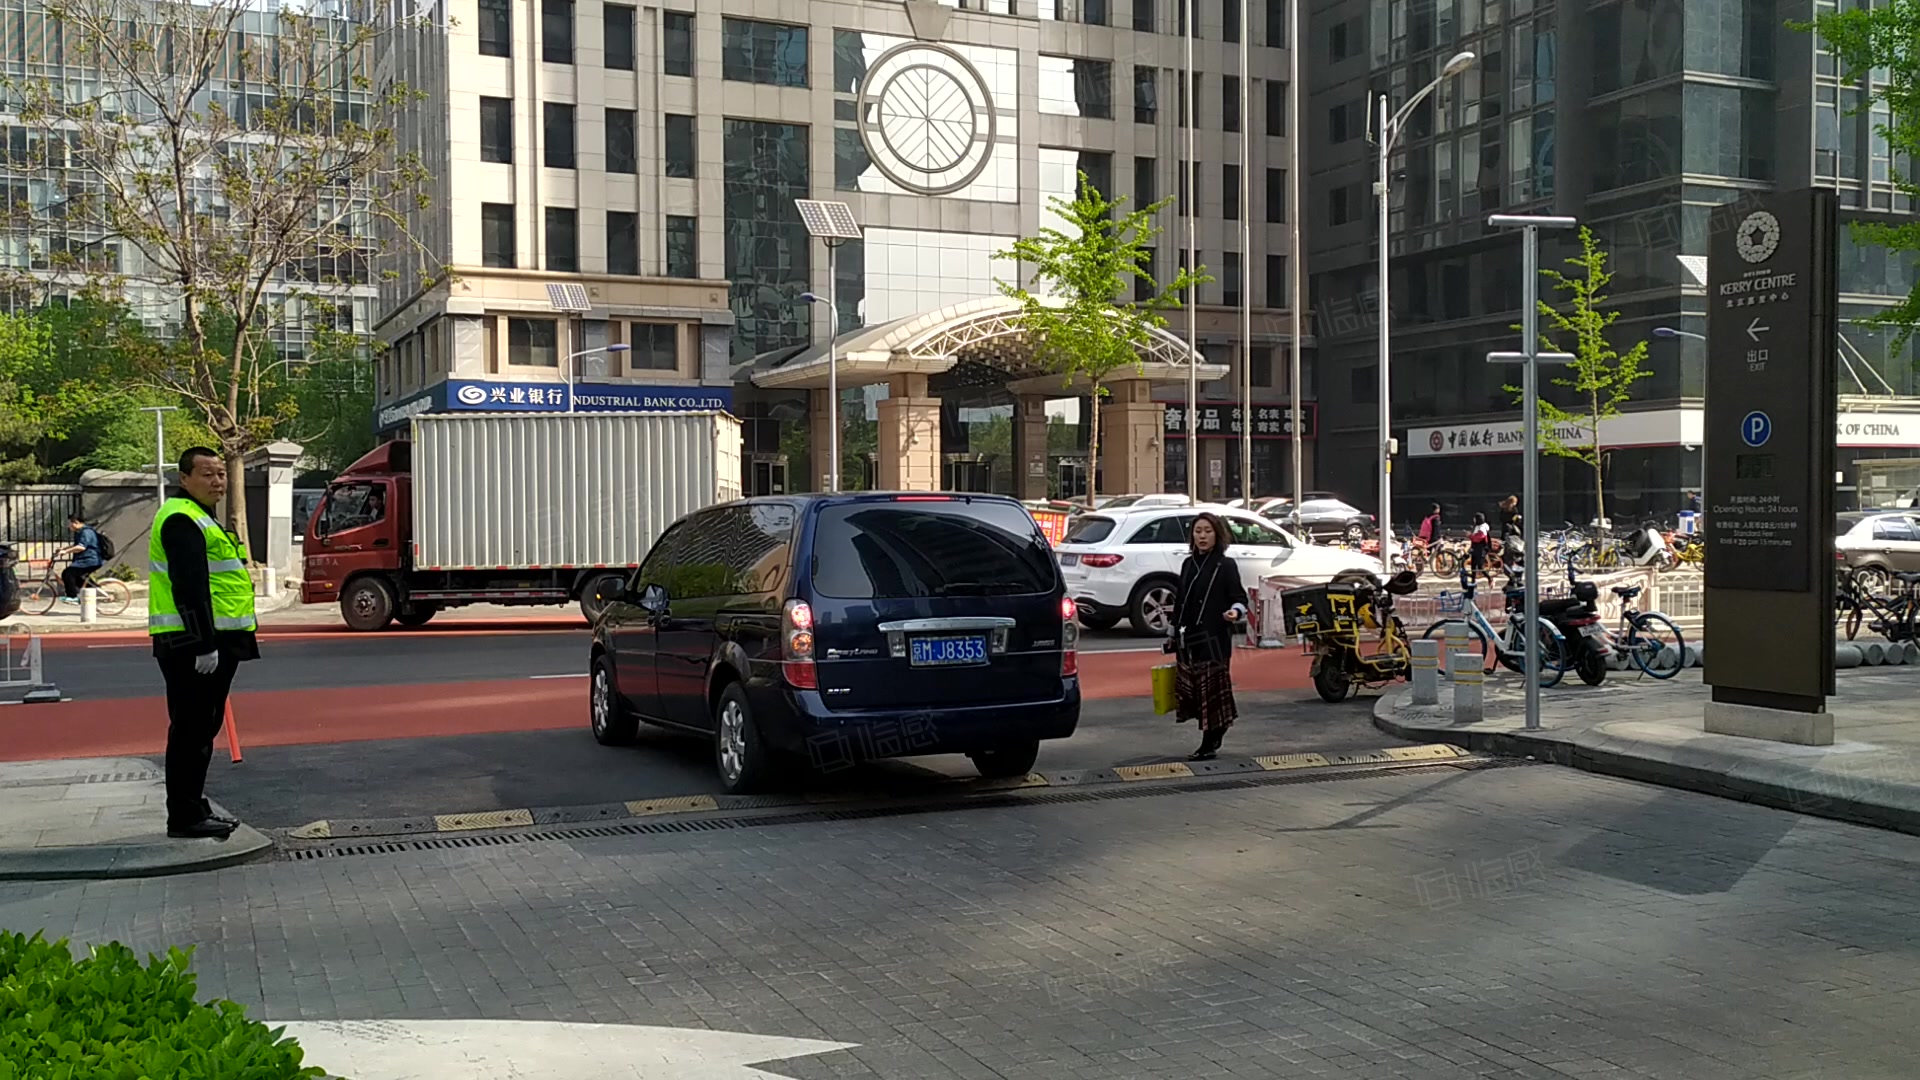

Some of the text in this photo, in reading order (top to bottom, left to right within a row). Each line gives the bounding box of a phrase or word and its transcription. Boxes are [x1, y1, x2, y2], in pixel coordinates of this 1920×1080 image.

[1720, 273, 1797, 296] KERRY CENTRE
[1747, 349, 1768, 363] 出口
[1750, 362, 1766, 372] EXIT
[490, 387, 563, 405] 兴业银行
[572, 395, 641, 407] NDUSTRIAL
[643, 397, 676, 408] BANK
[1231, 408, 1253, 420] 名
[1258, 408, 1280, 420] 名表
[1231, 421, 1253, 433] 钻
[1257, 421, 1280, 433] 寄卖
[1751, 417, 1764, 441] P
[1845, 423, 1861, 436] OF
[1863, 423, 1900, 436] CHINA
[1448, 428, 1494, 449] 中国银行
[1713, 505, 1744, 514] Opening
[1768, 505, 1777, 513] 24
[1778, 505, 1799, 513] hours
